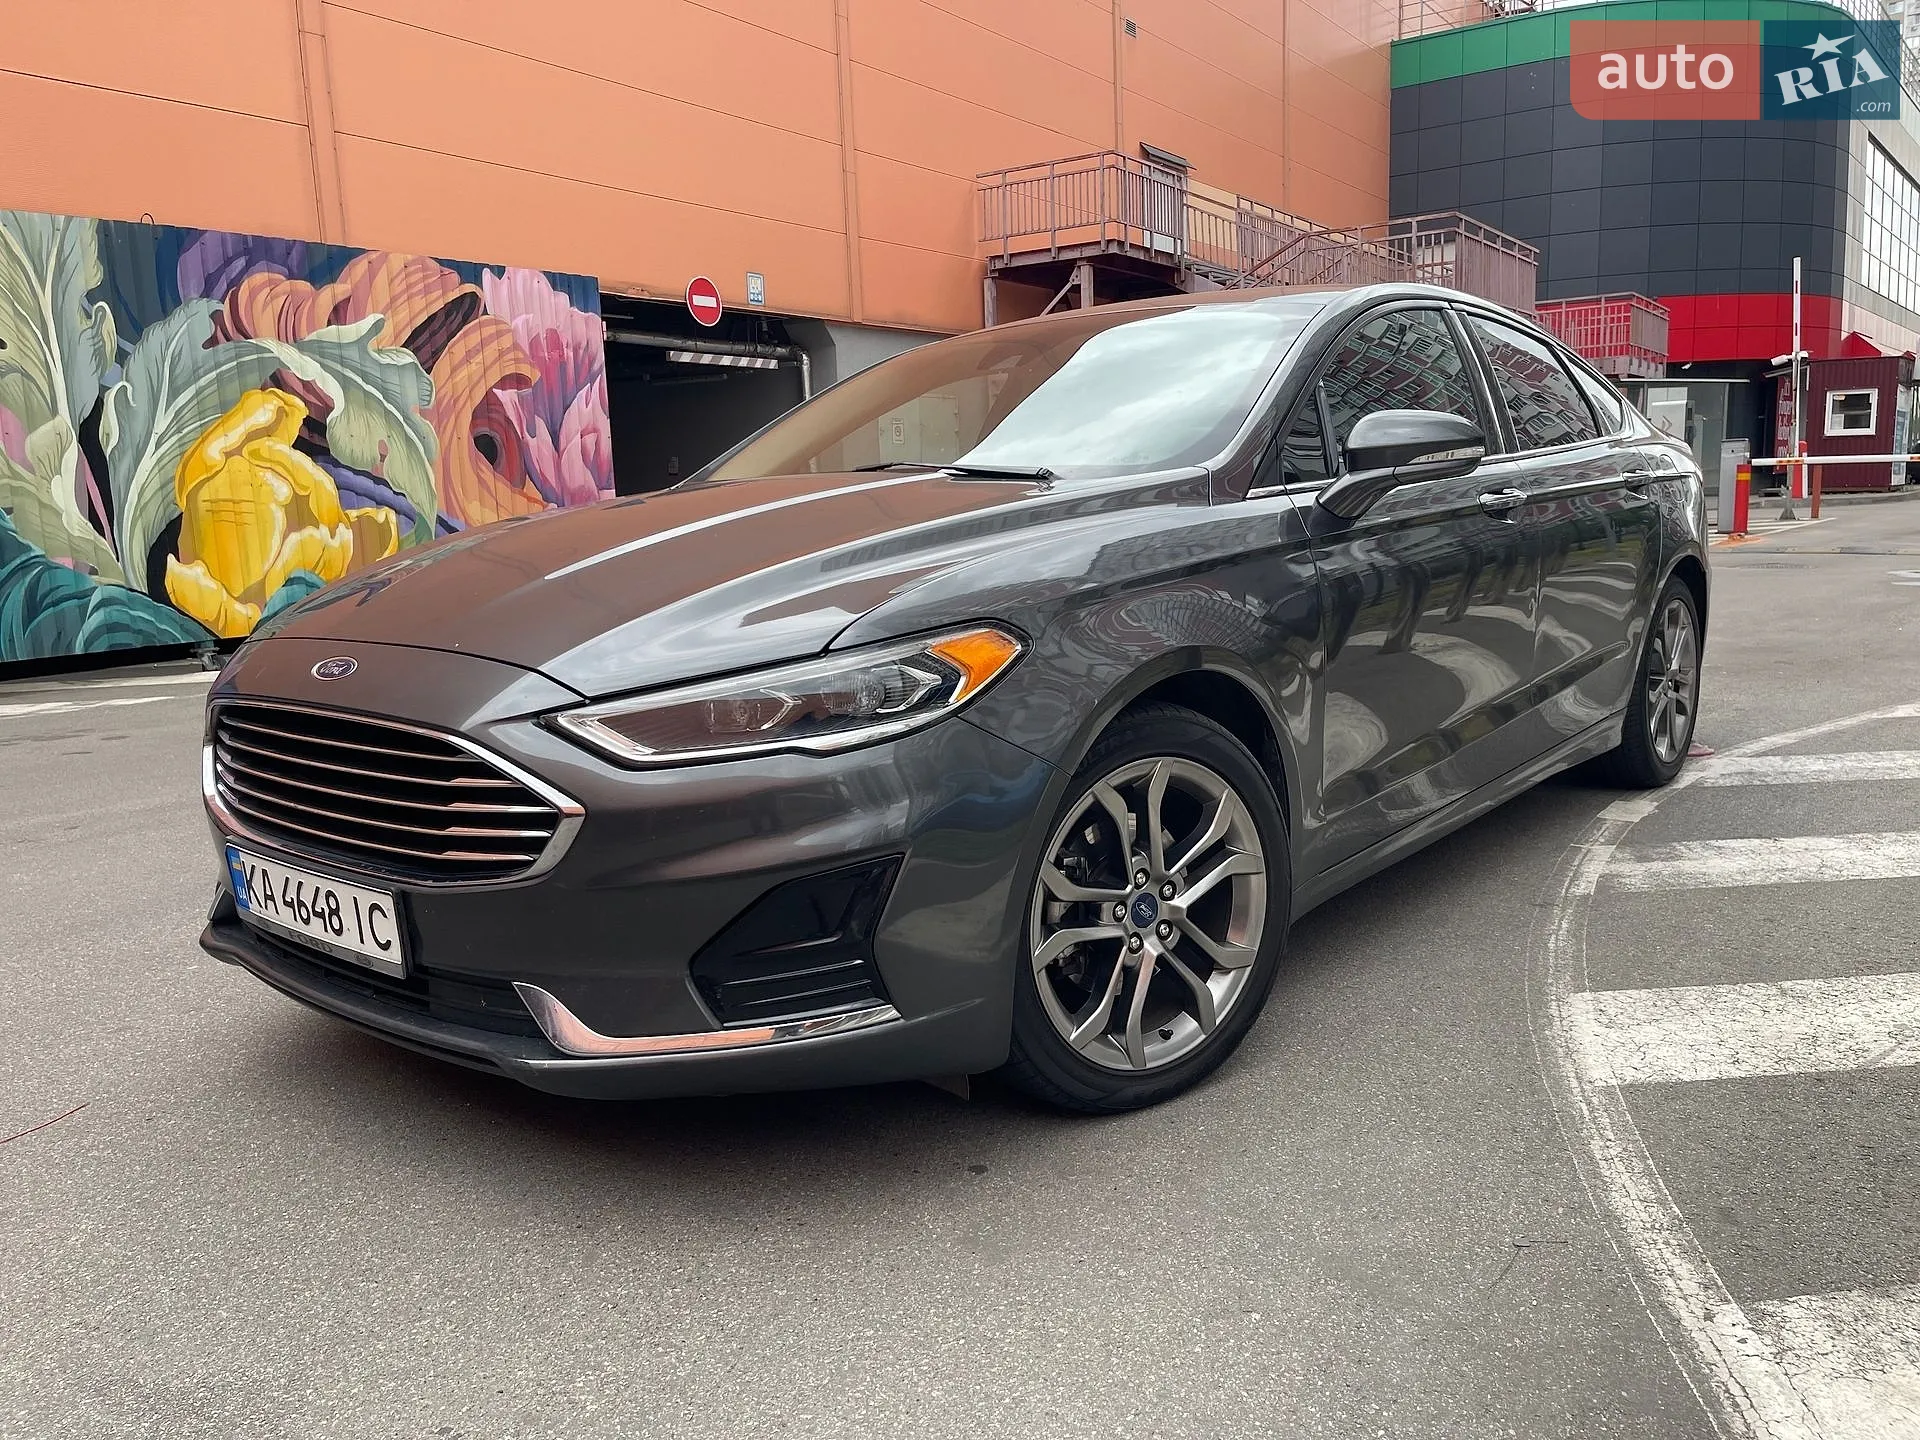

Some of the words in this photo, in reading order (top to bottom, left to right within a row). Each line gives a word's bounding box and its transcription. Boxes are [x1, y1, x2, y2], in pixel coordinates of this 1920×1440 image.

[236, 885, 249, 901] UA
[242, 860, 280, 915] KA
[282, 876, 344, 937] 4648
[352, 896, 392, 951] IC
